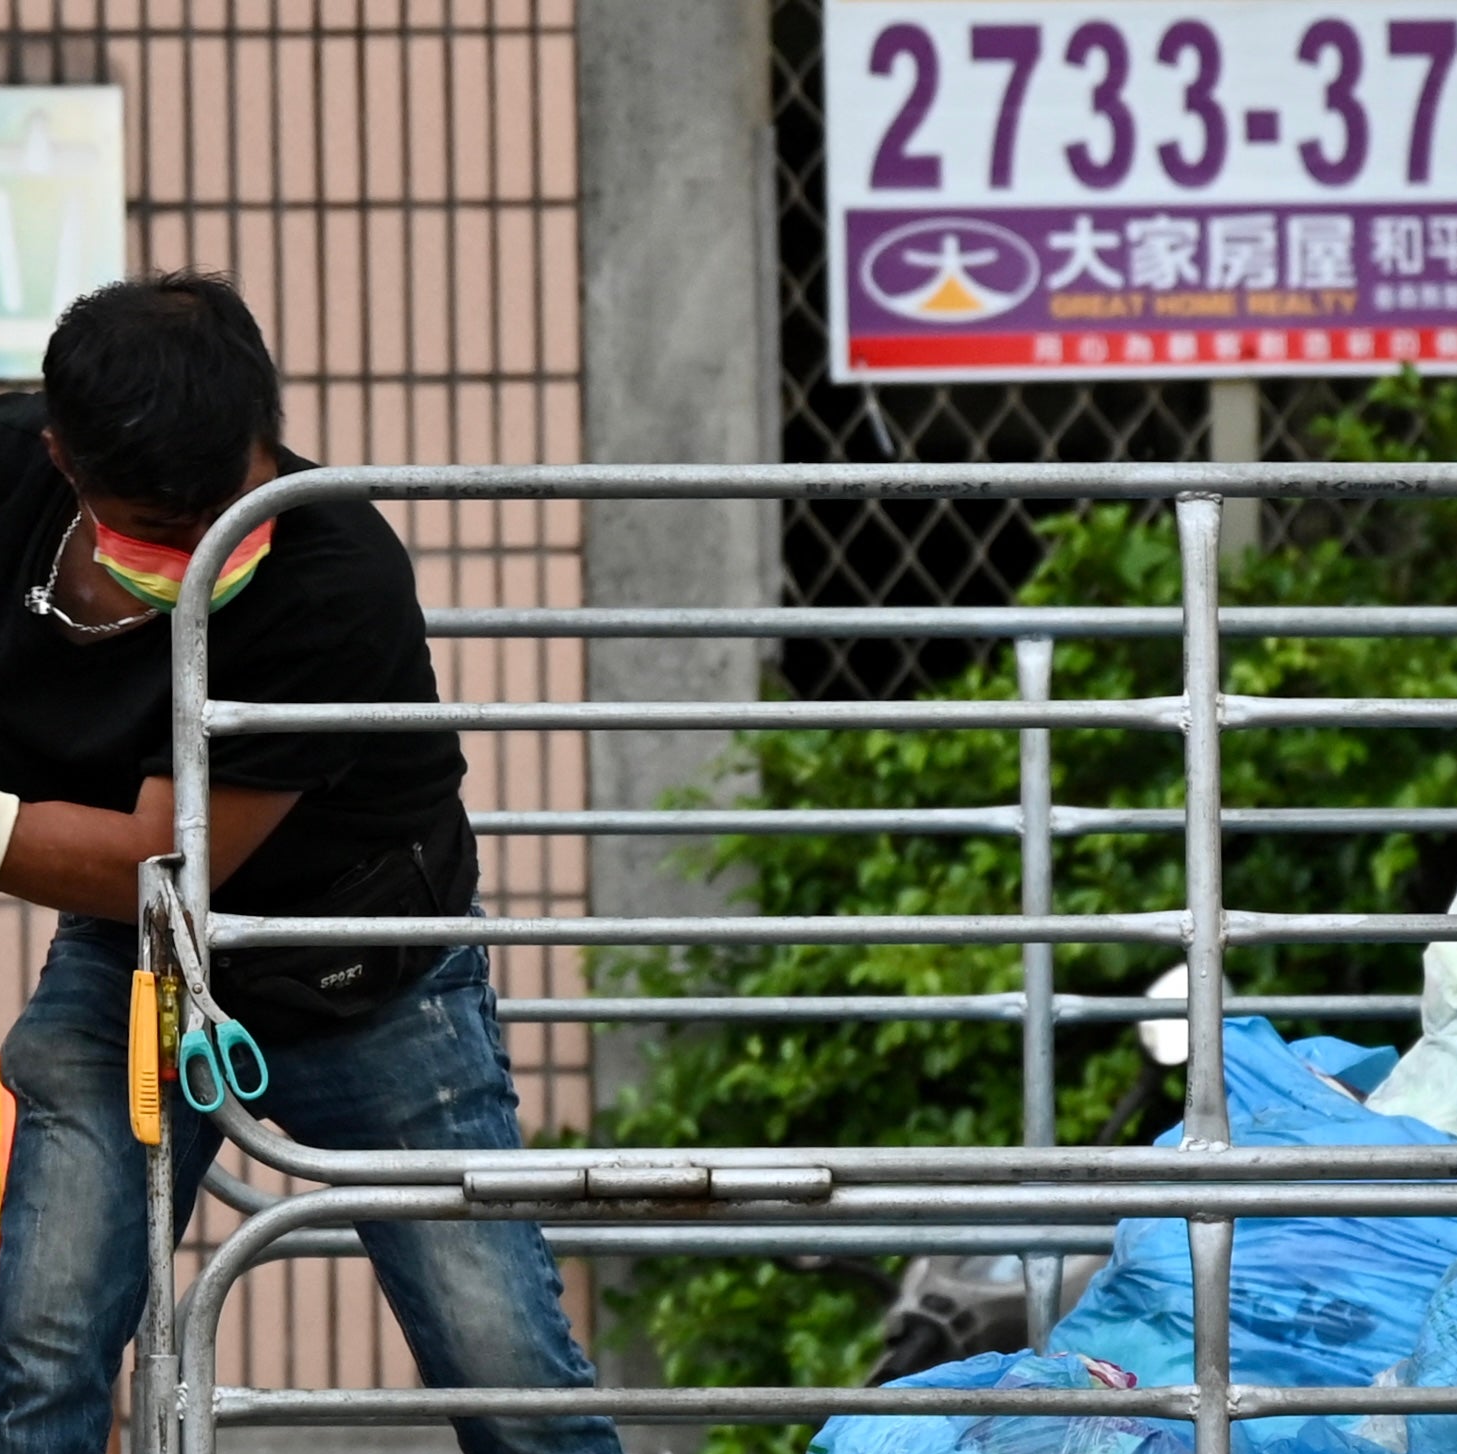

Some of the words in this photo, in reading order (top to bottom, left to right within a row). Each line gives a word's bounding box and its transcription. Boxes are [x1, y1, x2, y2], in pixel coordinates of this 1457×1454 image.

[1047, 215, 1358, 292] 大家房屋
[1050, 292, 1144, 319] GREAT
[1154, 291, 1238, 317] HOME
[1245, 289, 1357, 315] REALTY
[320, 963, 363, 989] SPORT
